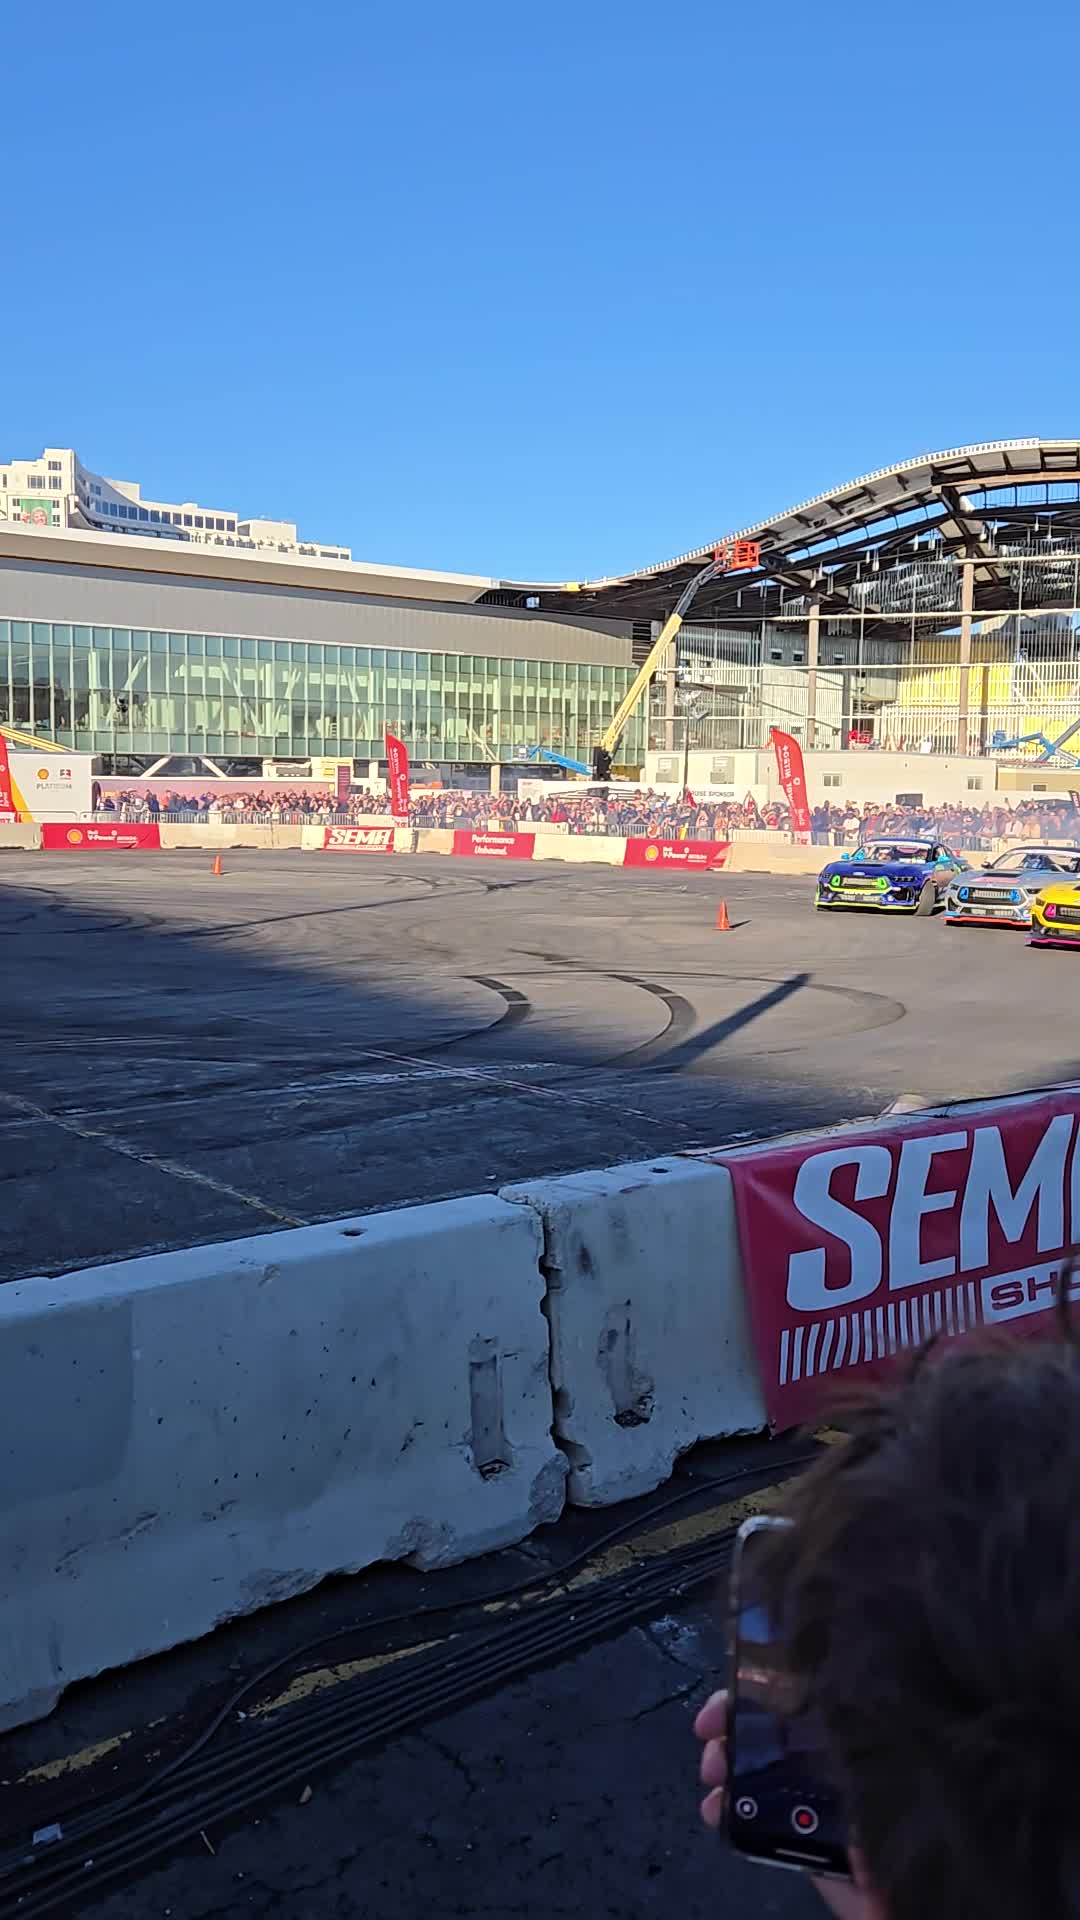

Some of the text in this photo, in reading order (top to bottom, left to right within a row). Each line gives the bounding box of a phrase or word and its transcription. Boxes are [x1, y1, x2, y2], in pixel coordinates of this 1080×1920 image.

[328, 828, 393, 845] SEMA
[472, 834, 516, 845] Performance
[786, 1113, 1080, 1311] SEM
